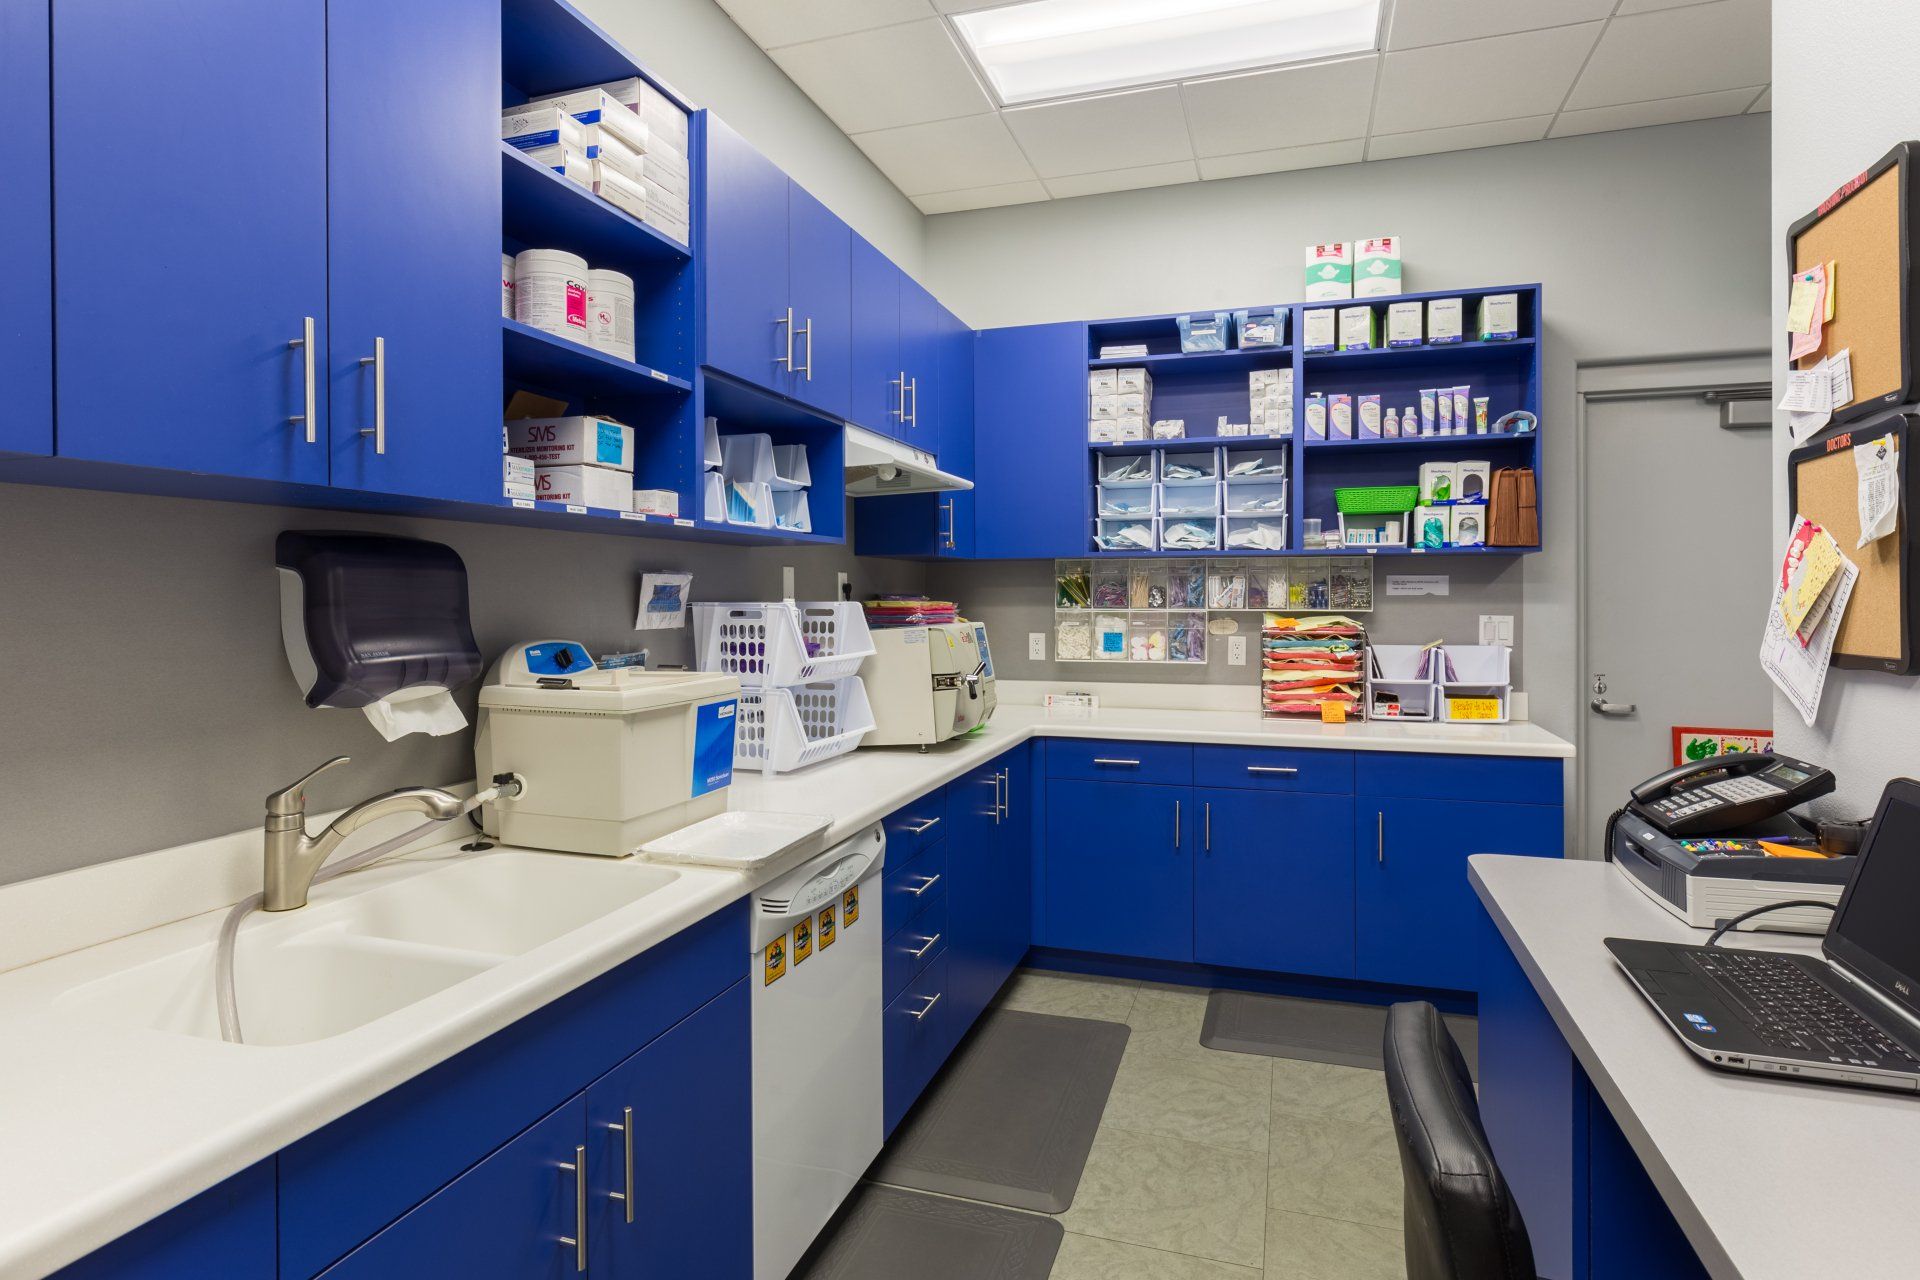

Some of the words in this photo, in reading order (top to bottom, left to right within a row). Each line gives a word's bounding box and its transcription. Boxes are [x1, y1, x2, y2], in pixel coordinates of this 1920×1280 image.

[528, 426, 556, 443] SMS
[1826, 432, 1852, 452] DOCTORS
[1894, 980, 1910, 996] DELL
